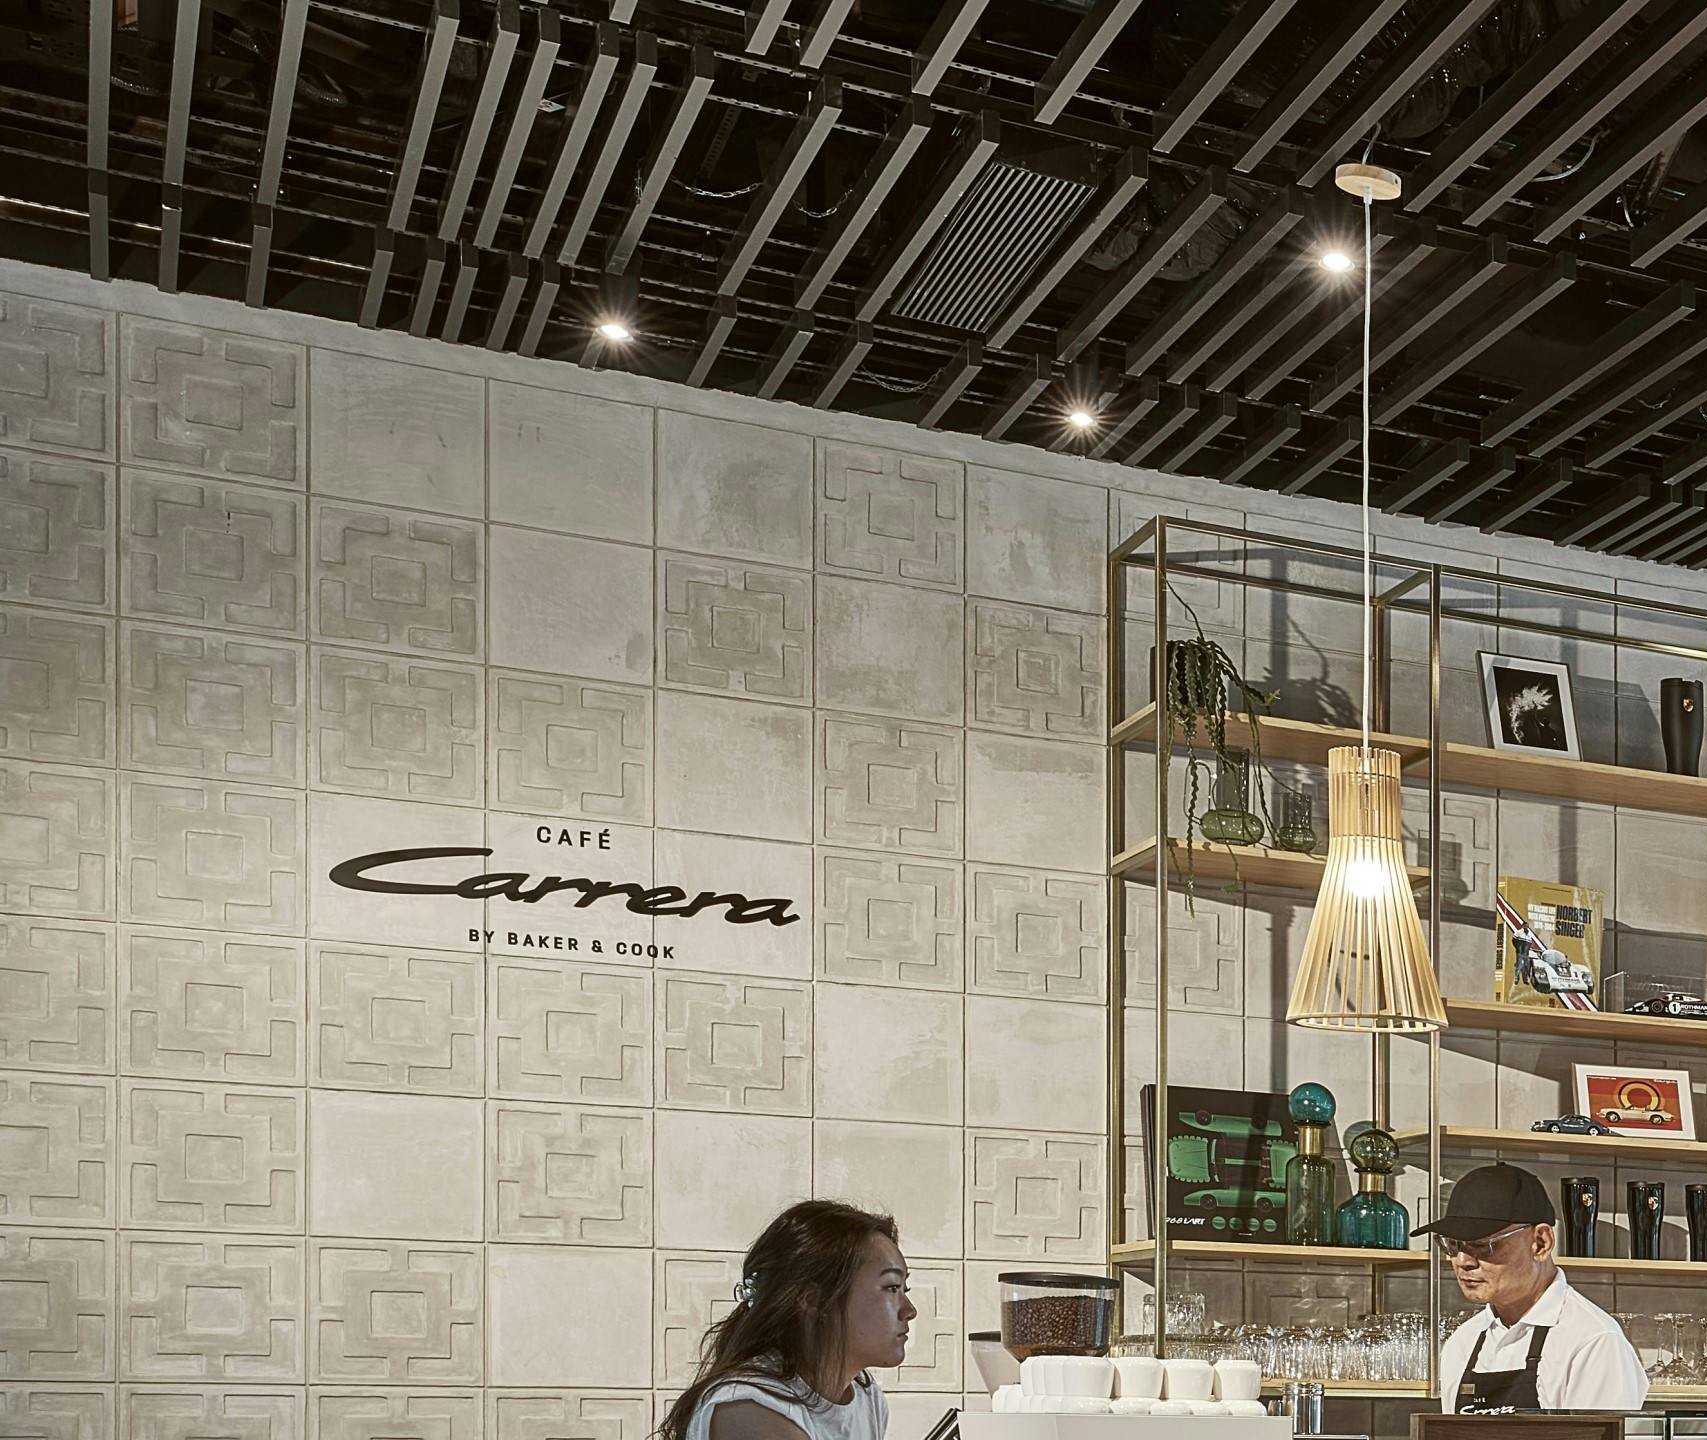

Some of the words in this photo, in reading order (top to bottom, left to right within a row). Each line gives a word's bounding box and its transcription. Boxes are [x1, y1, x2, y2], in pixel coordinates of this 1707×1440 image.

[536, 825, 612, 850] CAFÉ
[329, 846, 801, 926] Carrera
[1556, 904, 1593, 925] NORBERT
[1556, 921, 1585, 938] SINGER
[469, 928, 495, 943] BY
[507, 932, 580, 951] BAKER
[592, 938, 604, 953] &
[616, 941, 676, 959] COOK
